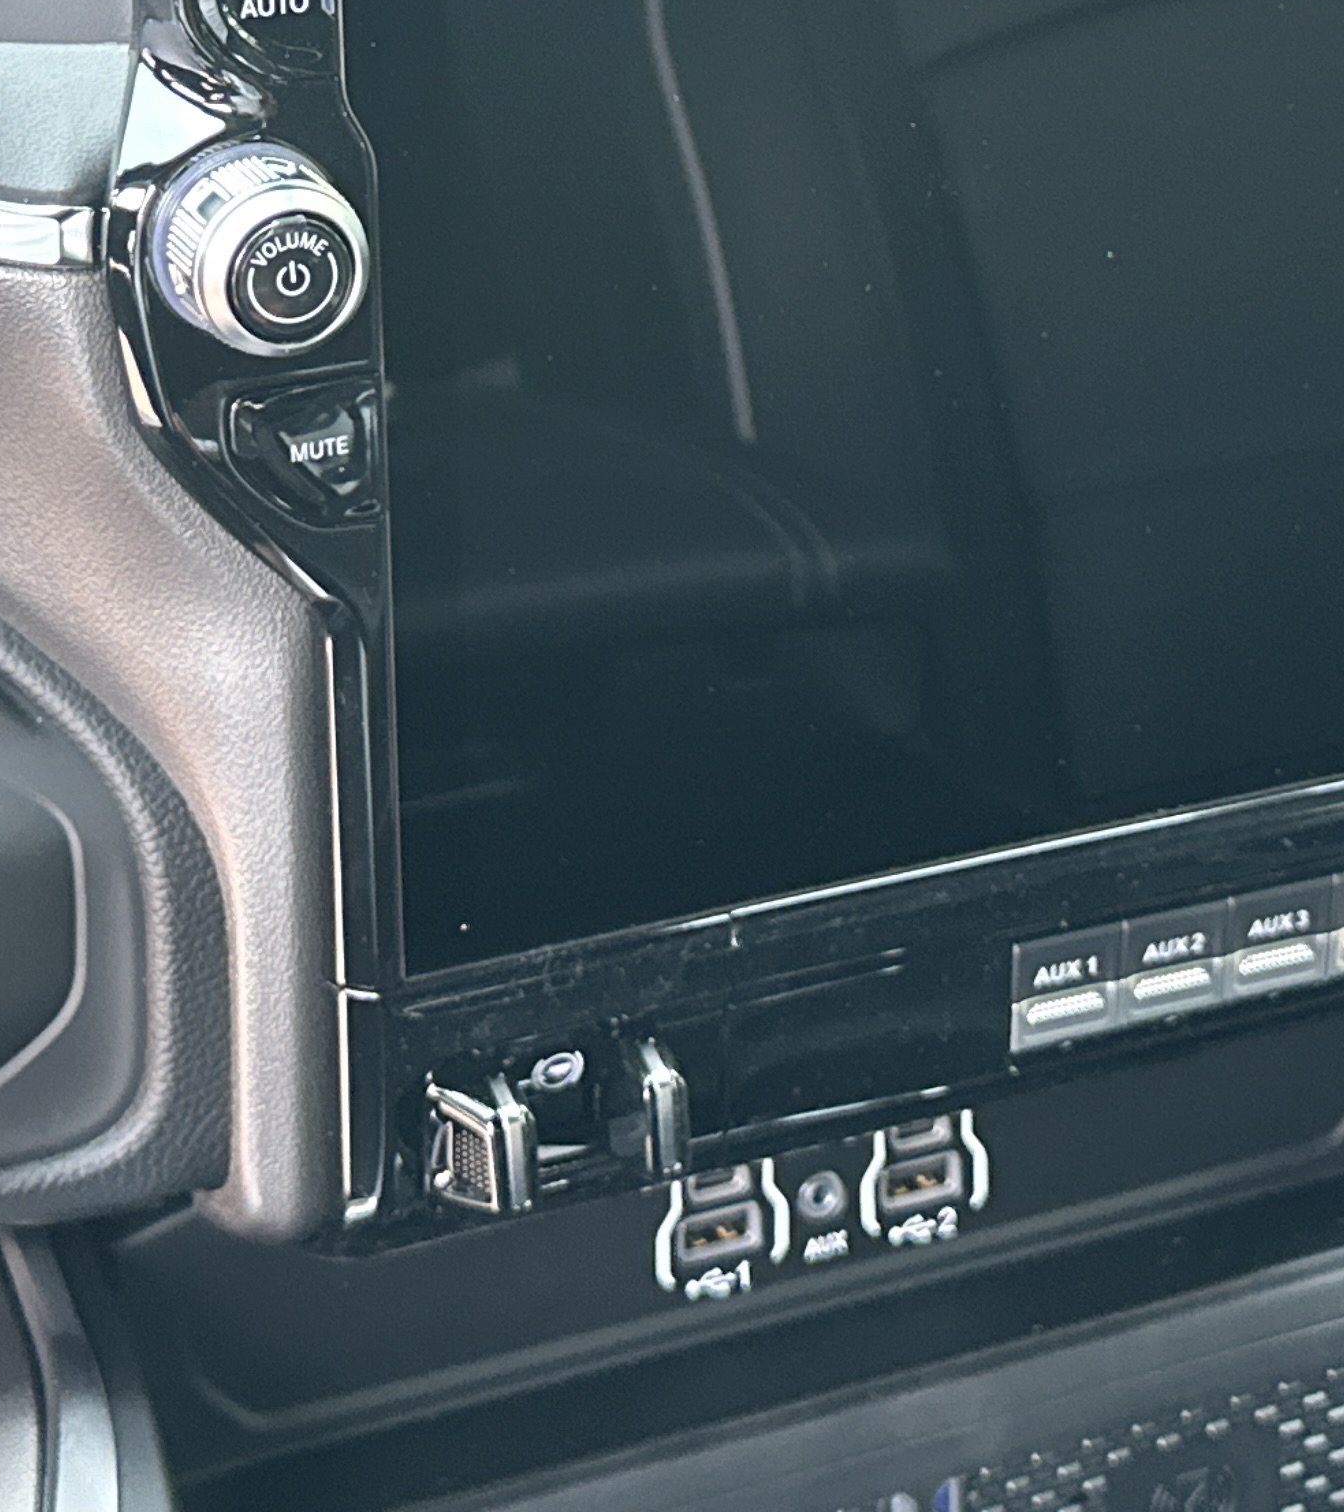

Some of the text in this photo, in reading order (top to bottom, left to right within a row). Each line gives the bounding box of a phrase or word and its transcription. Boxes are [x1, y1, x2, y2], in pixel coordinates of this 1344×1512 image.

[250, 231, 330, 269] VOLUME
[289, 434, 350, 464] MUTE
[1247, 909, 1311, 939] AUX 3
[1142, 932, 1208, 963] AUX 2
[1033, 955, 1099, 988] AUX 1
